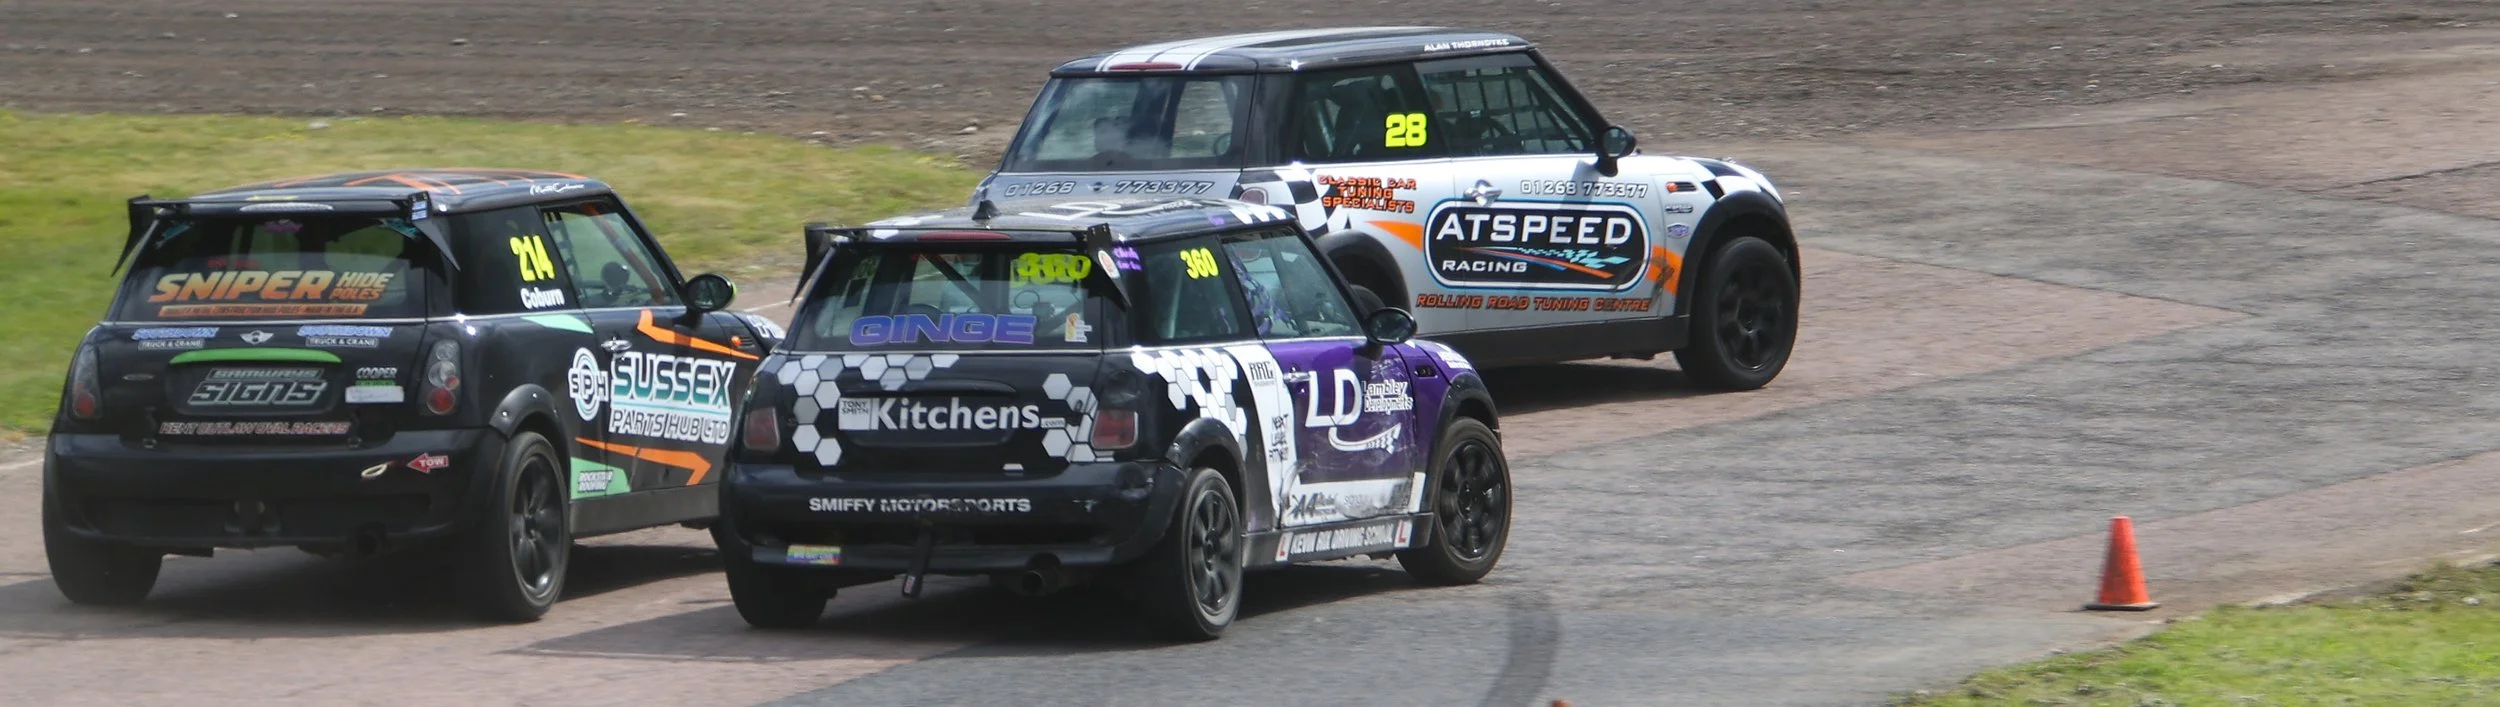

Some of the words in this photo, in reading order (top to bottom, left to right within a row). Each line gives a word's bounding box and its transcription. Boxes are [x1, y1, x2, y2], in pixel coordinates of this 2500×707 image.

[1424, 43, 1451, 52] ALAN
[1385, 113, 1427, 147] 28
[1005, 180, 1076, 197] 01268
[1113, 180, 1216, 194] 773377
[1317, 174, 1382, 188] CLASSIC
[1387, 177, 1417, 190] CAR
[1520, 180, 1578, 195] 01268
[1583, 182, 1648, 198] 773377
[1337, 186, 1394, 200] TUNING
[1321, 196, 1415, 214] SPECIALISTS
[1436, 212, 1632, 245] ATSPEED
[510, 235, 556, 282] 214
[1180, 247, 1220, 279] 360
[1442, 259, 1528, 273] RACING
[148, 270, 335, 303] SNIPER
[336, 271, 394, 288] HIDE
[329, 288, 386, 301] POLES
[520, 286, 566, 309] Coburn
[1416, 294, 1484, 310] ROLLING
[1486, 294, 1529, 311] ROAD
[1533, 296, 1590, 312] TUNING
[1593, 297, 1650, 312] CENTRE
[850, 313, 1037, 346] GINGE
[356, 367, 397, 379] COOPER
[611, 352, 736, 408] SUSSEX
[187, 381, 328, 405] SIGNS
[568, 367, 610, 402] SPH
[1363, 379, 1408, 396] Lambley
[842, 400, 868, 408] TONY
[1305, 368, 1362, 428] LD
[1364, 394, 1414, 415] Developments
[609, 409, 665, 437] PARTS
[664, 413, 701, 440] HUB
[701, 417, 731, 445] LTD
[419, 457, 445, 467] TOW
[809, 498, 875, 513] SMIFFY
